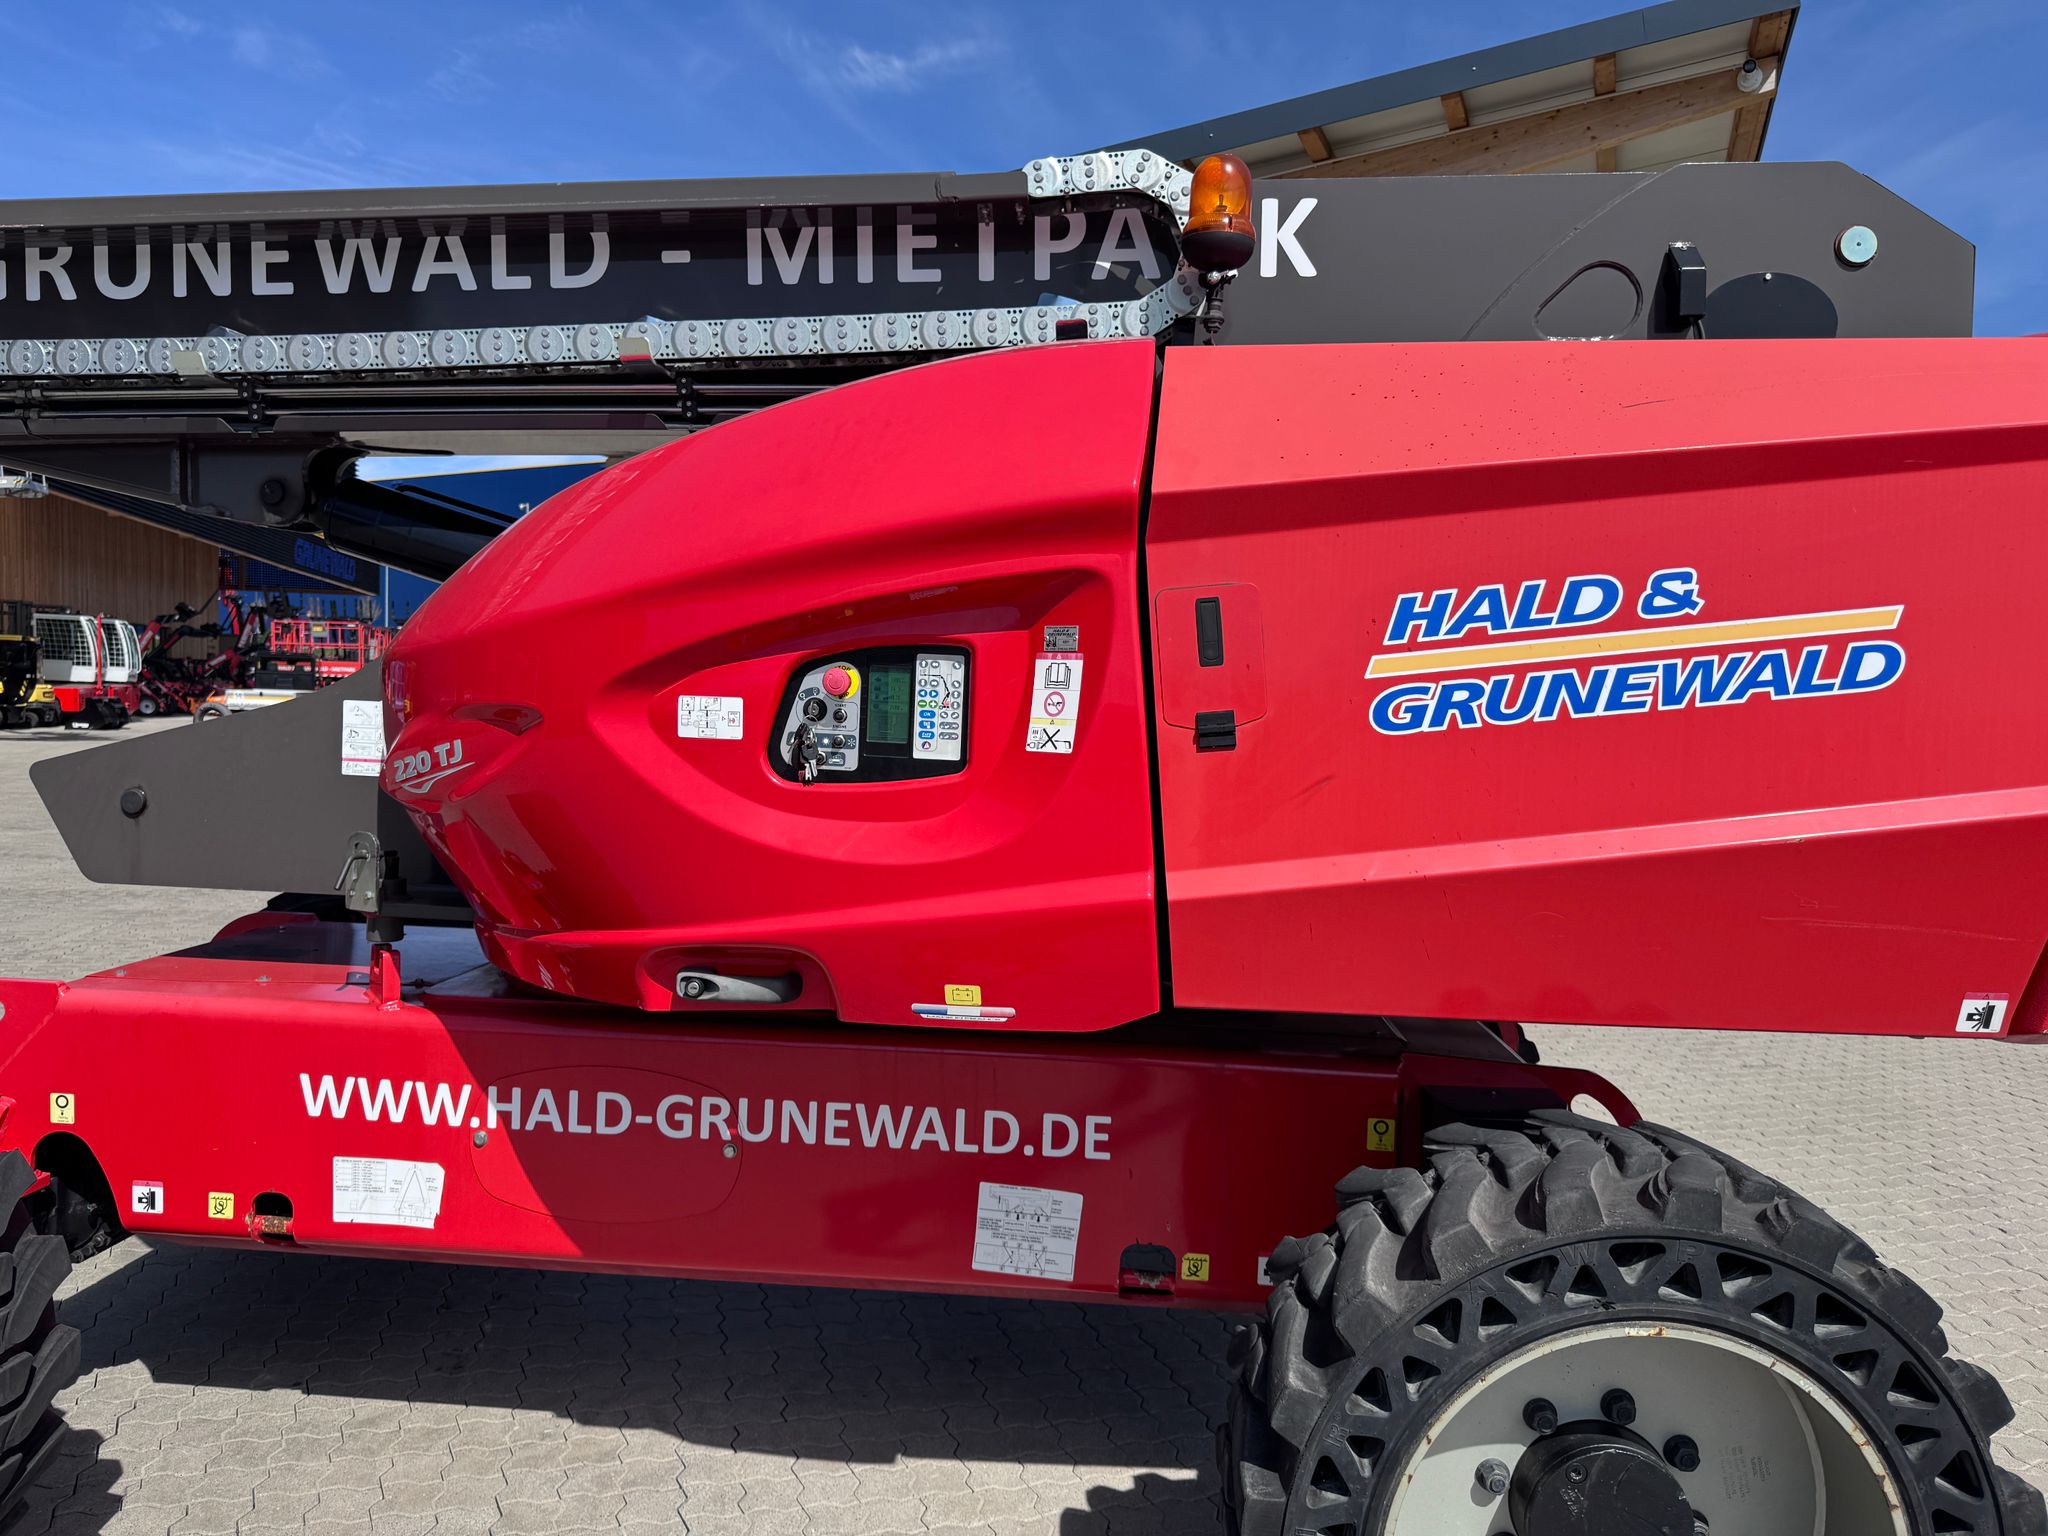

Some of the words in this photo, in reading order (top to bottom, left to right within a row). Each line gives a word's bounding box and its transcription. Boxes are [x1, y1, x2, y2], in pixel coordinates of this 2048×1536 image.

[0, 226, 611, 301] RUNEWALD
[1384, 573, 1622, 645] HALD
[1638, 566, 1704, 618] &
[1369, 640, 1906, 736] GRUNEWALD
[393, 750, 432, 783] 220
[433, 739, 463, 767] TJ
[300, 1072, 1113, 1162] WWW.HALD-GRUNEWALD.DE
